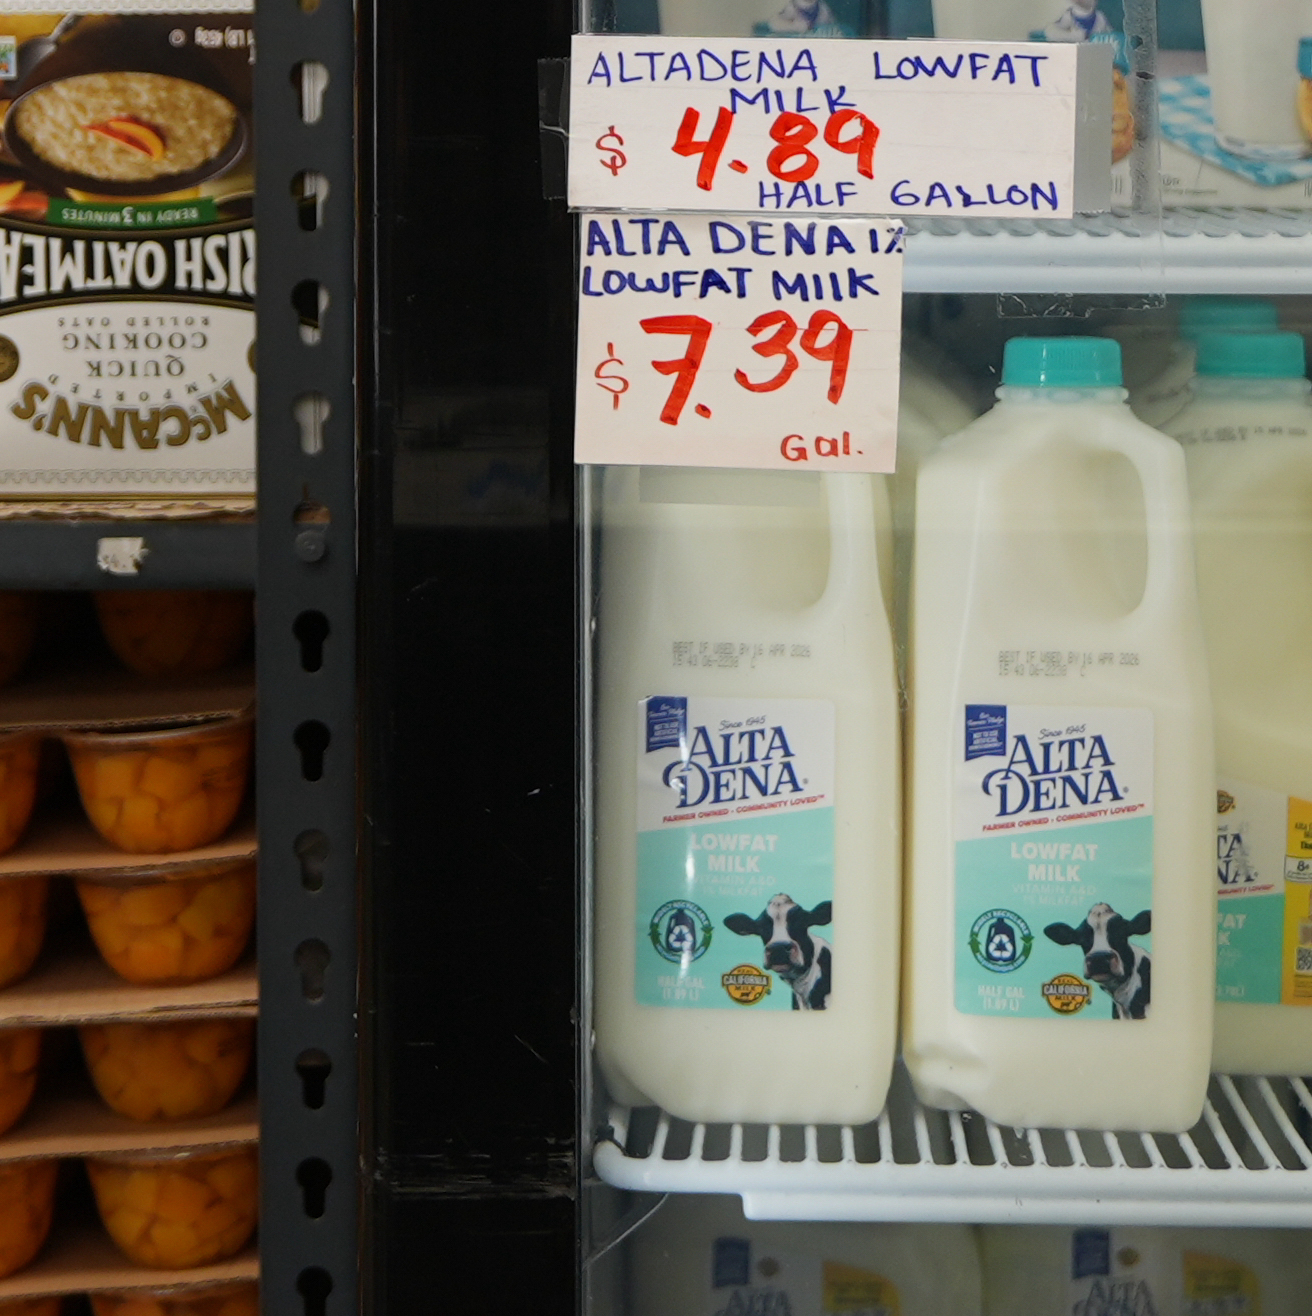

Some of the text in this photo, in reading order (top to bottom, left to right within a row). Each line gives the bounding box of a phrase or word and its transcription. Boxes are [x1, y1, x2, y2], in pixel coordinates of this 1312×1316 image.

[587, 48, 1050, 87] ALTADENA LOWFAT
[729, 86, 858, 115] MILK
[595, 106, 880, 192] $ 4.89
[758, 181, 859, 208] HALF
[62, 207, 198, 224] READY IN 3 MINUTES
[586, 219, 690, 257] ALTA
[710, 221, 853, 256] DENA
[582, 267, 753, 300] LOWFAT
[57, 316, 209, 326] ROLLED OATS
[63, 332, 208, 350] COOKING
[86, 355, 183, 378] QUICK
[594, 308, 854, 426] $ 7.39
[781, 431, 863, 461] Gal.
[687, 725, 795, 769] ALTA
[1000, 734, 1115, 780] ALTA
[662, 760, 803, 809] DENA
[981, 768, 1124, 817] DENA
[690, 833, 778, 853] LOWFAT
[1011, 843, 1098, 861] LOWFAT
[707, 854, 759, 873] MILK
[1028, 863, 1081, 882] MILK
